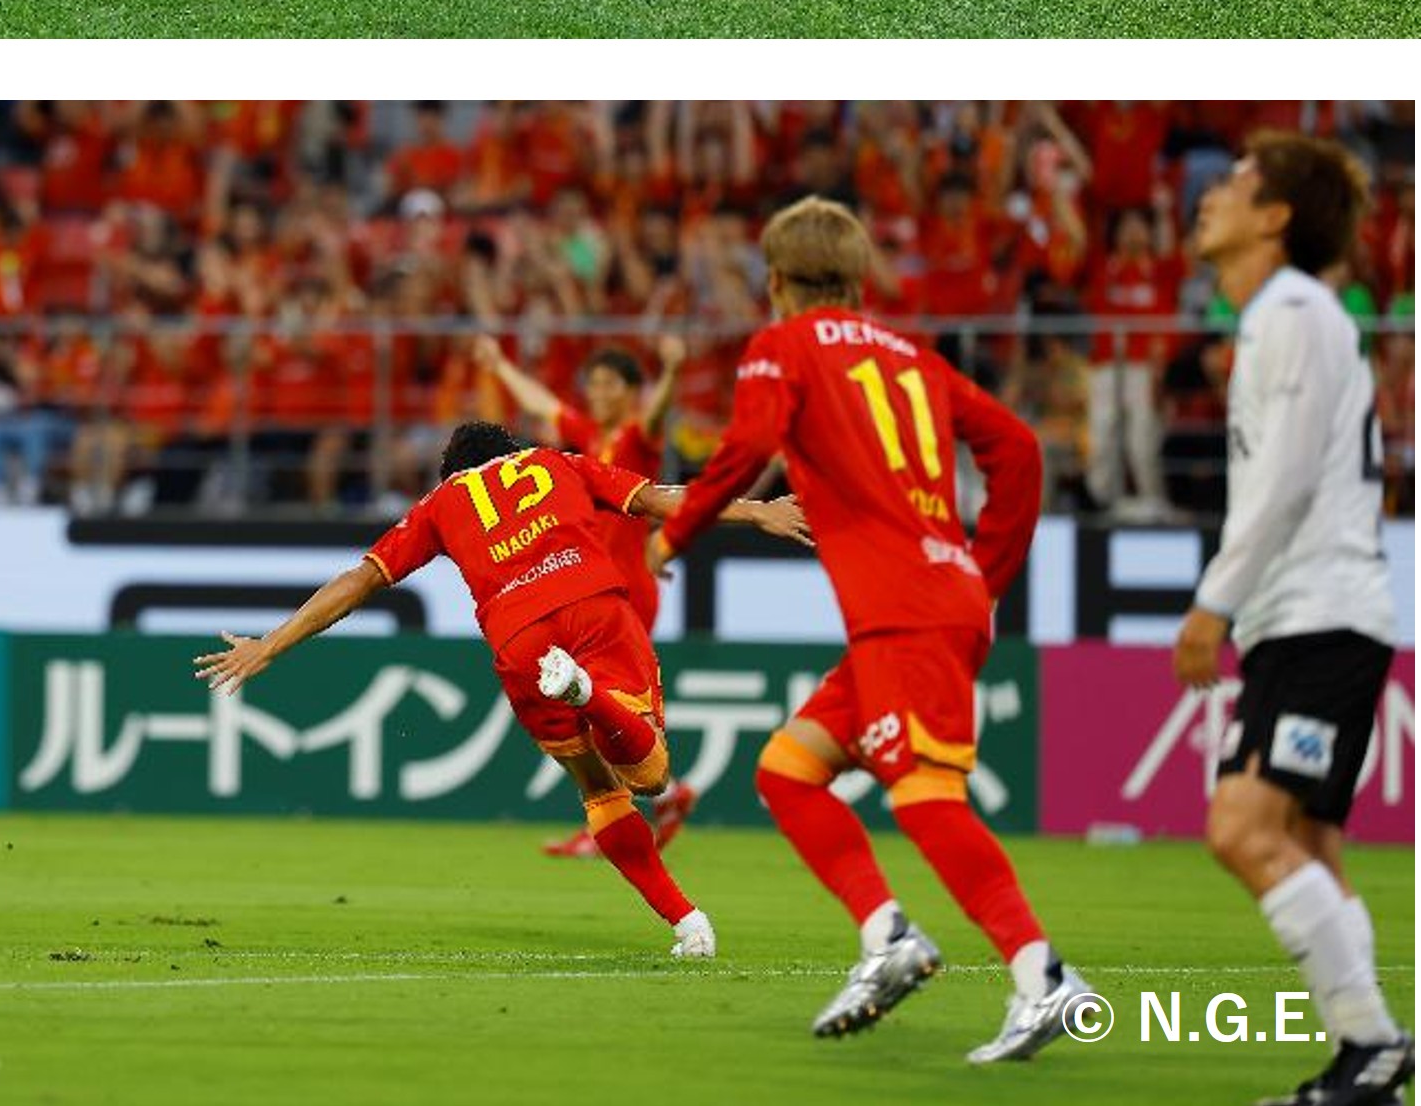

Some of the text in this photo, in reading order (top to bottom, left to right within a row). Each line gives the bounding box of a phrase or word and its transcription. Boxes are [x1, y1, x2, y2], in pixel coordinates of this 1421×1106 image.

[845, 356, 943, 481] 11
[452, 446, 555, 533] 15
[488, 513, 560, 564] INAGAKI
[18, 658, 1022, 814] ルートインテ
